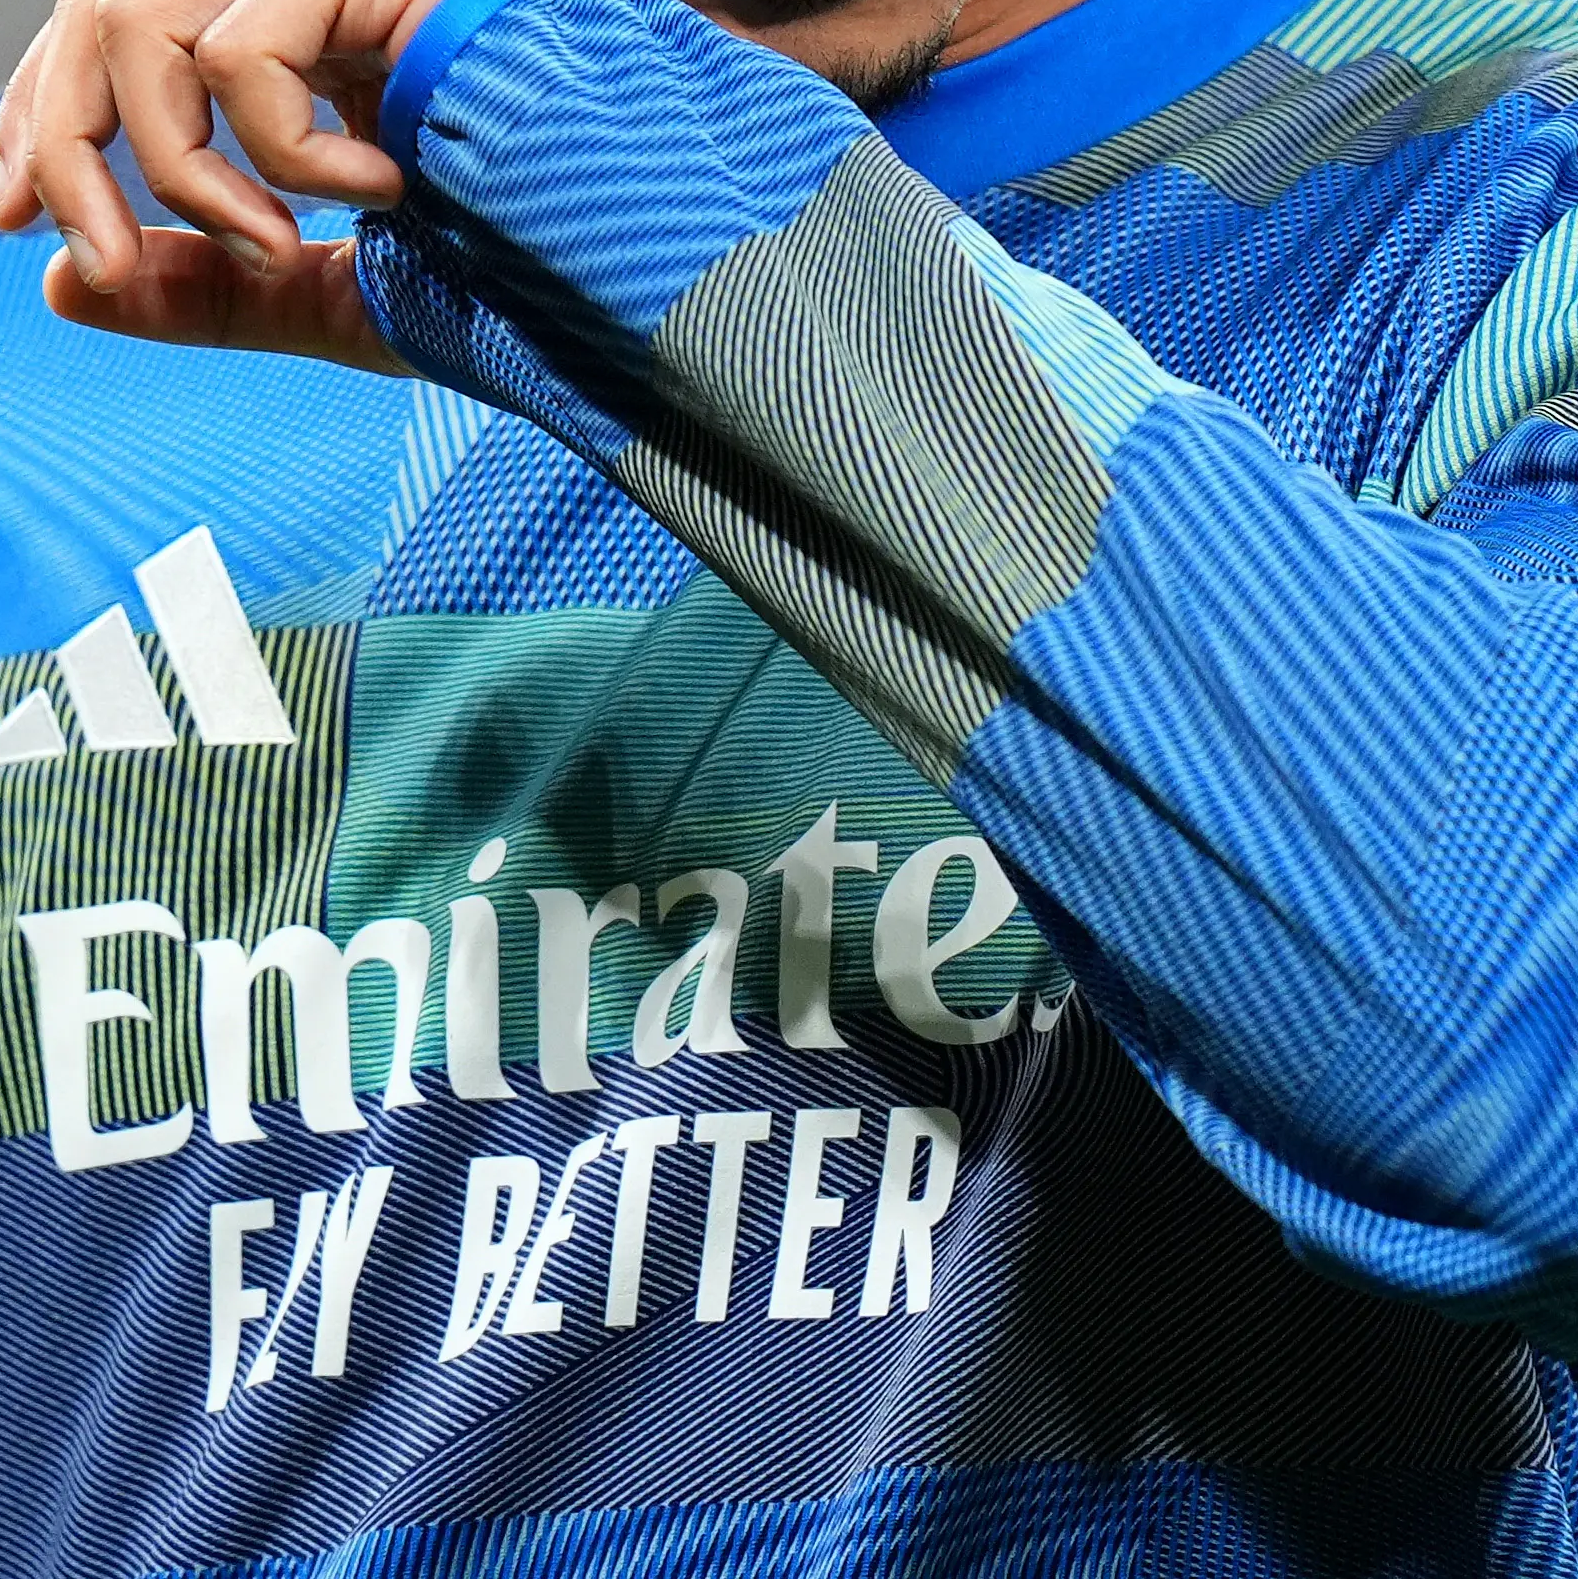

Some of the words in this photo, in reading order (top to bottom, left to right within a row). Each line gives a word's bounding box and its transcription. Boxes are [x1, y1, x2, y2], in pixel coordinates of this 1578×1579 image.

[18, 800, 1076, 1172] Emirate
[206, 1165, 394, 1413] FLY
[438, 1106, 961, 1364] BETTER
